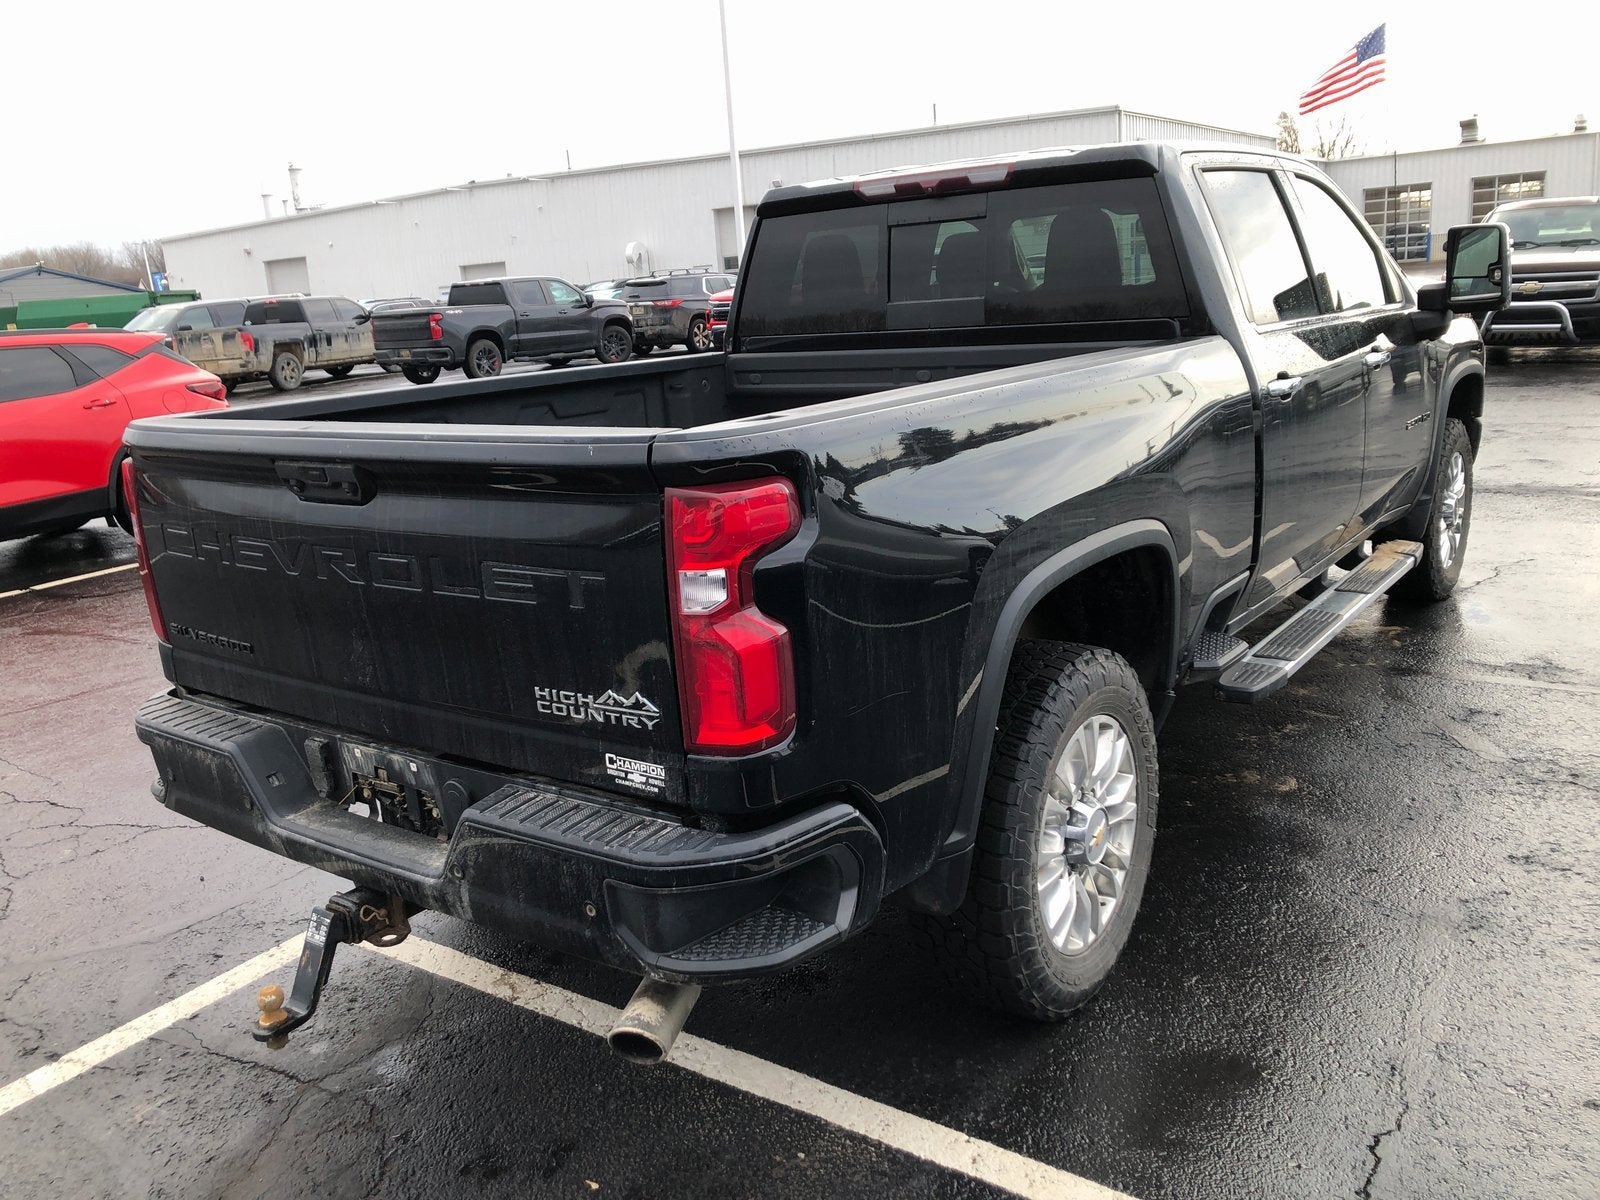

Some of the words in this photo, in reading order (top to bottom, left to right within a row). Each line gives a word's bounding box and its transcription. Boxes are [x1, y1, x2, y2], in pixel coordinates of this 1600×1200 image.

[161, 523, 605, 609] CHEVROLET
[169, 622, 255, 655] SILVERADO
[534, 686, 594, 707] HIGH
[536, 700, 661, 730] COUNTRY
[1127, 696, 1154, 749] TOYO
[605, 753, 666, 777] CHAMPION
[615, 778, 659, 793] CHAMPCHEV.COM
